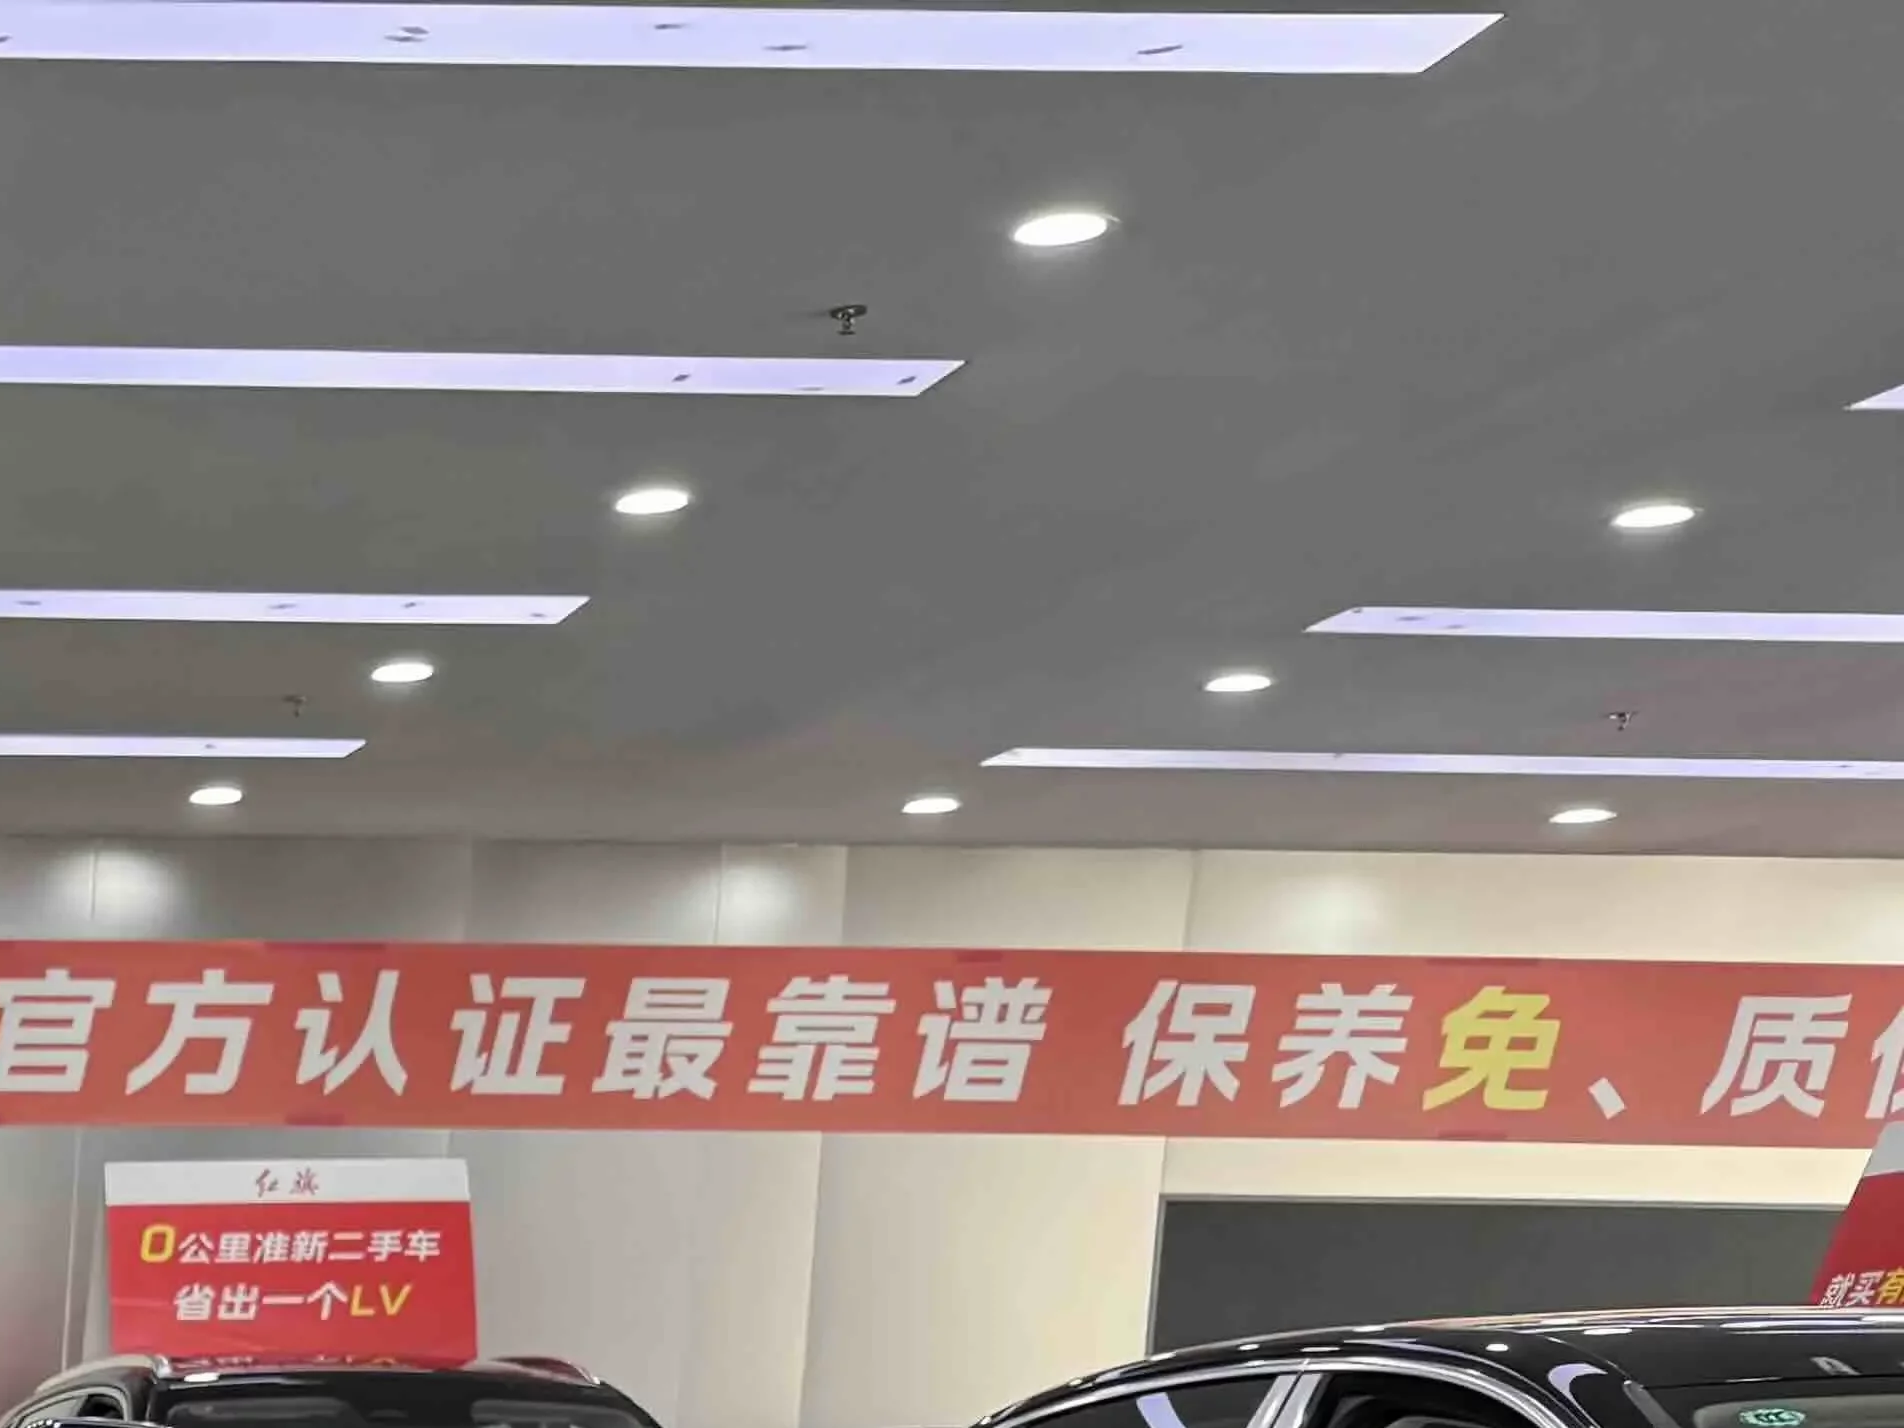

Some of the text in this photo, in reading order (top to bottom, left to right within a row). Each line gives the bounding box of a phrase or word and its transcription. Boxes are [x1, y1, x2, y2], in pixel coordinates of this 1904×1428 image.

[139, 1222, 442, 1267] 0公里准新二手车
[173, 1282, 414, 1323] 省出一个LV
